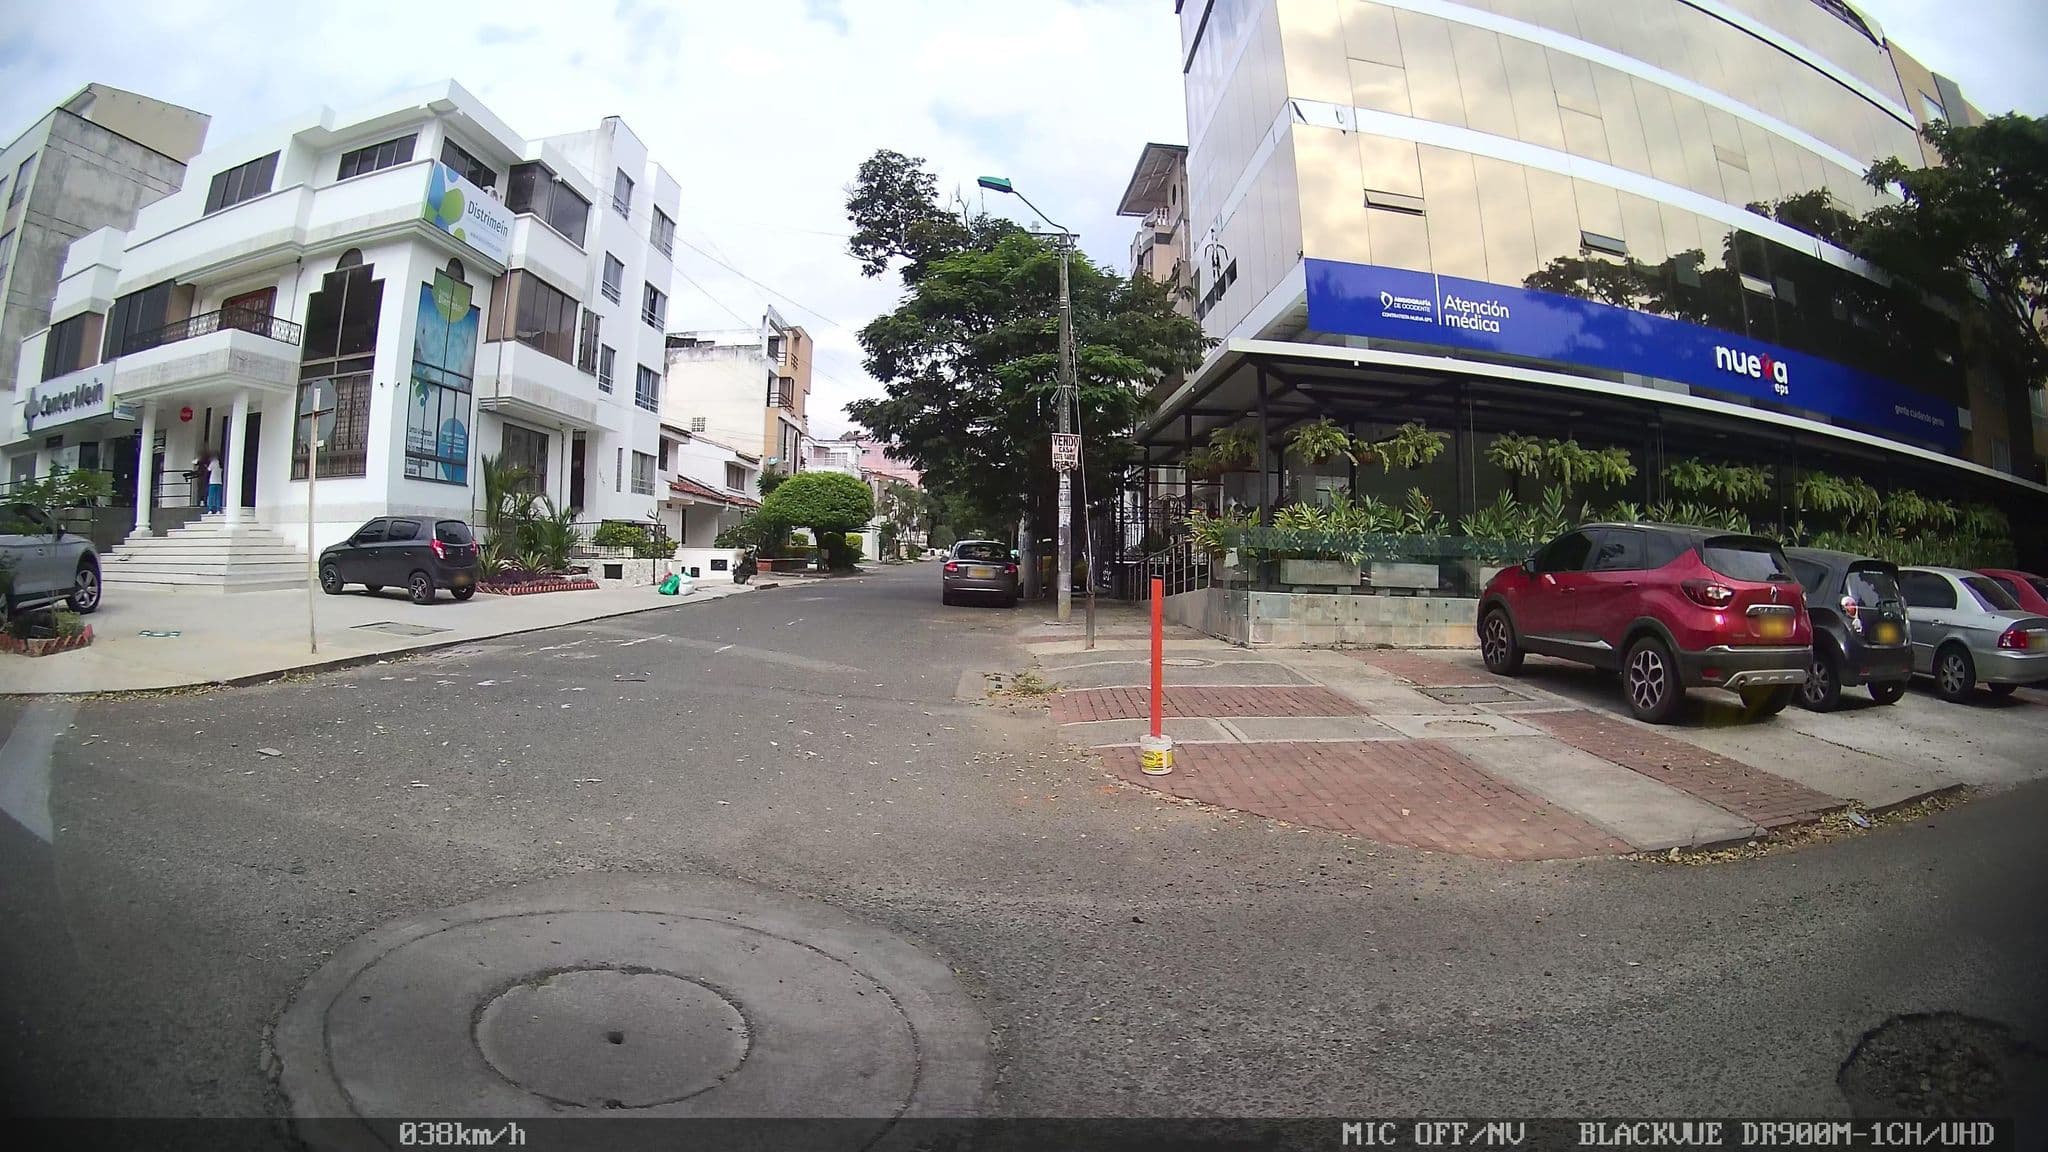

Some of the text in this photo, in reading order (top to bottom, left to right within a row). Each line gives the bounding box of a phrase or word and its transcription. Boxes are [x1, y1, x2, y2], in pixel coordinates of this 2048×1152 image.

[468, 201, 508, 237] Distrimein
[1444, 295, 1509, 318] Atención
[1445, 313, 1500, 333] médica
[1774, 383, 1789, 396] eps
[1053, 435, 1079, 447] VENDO
